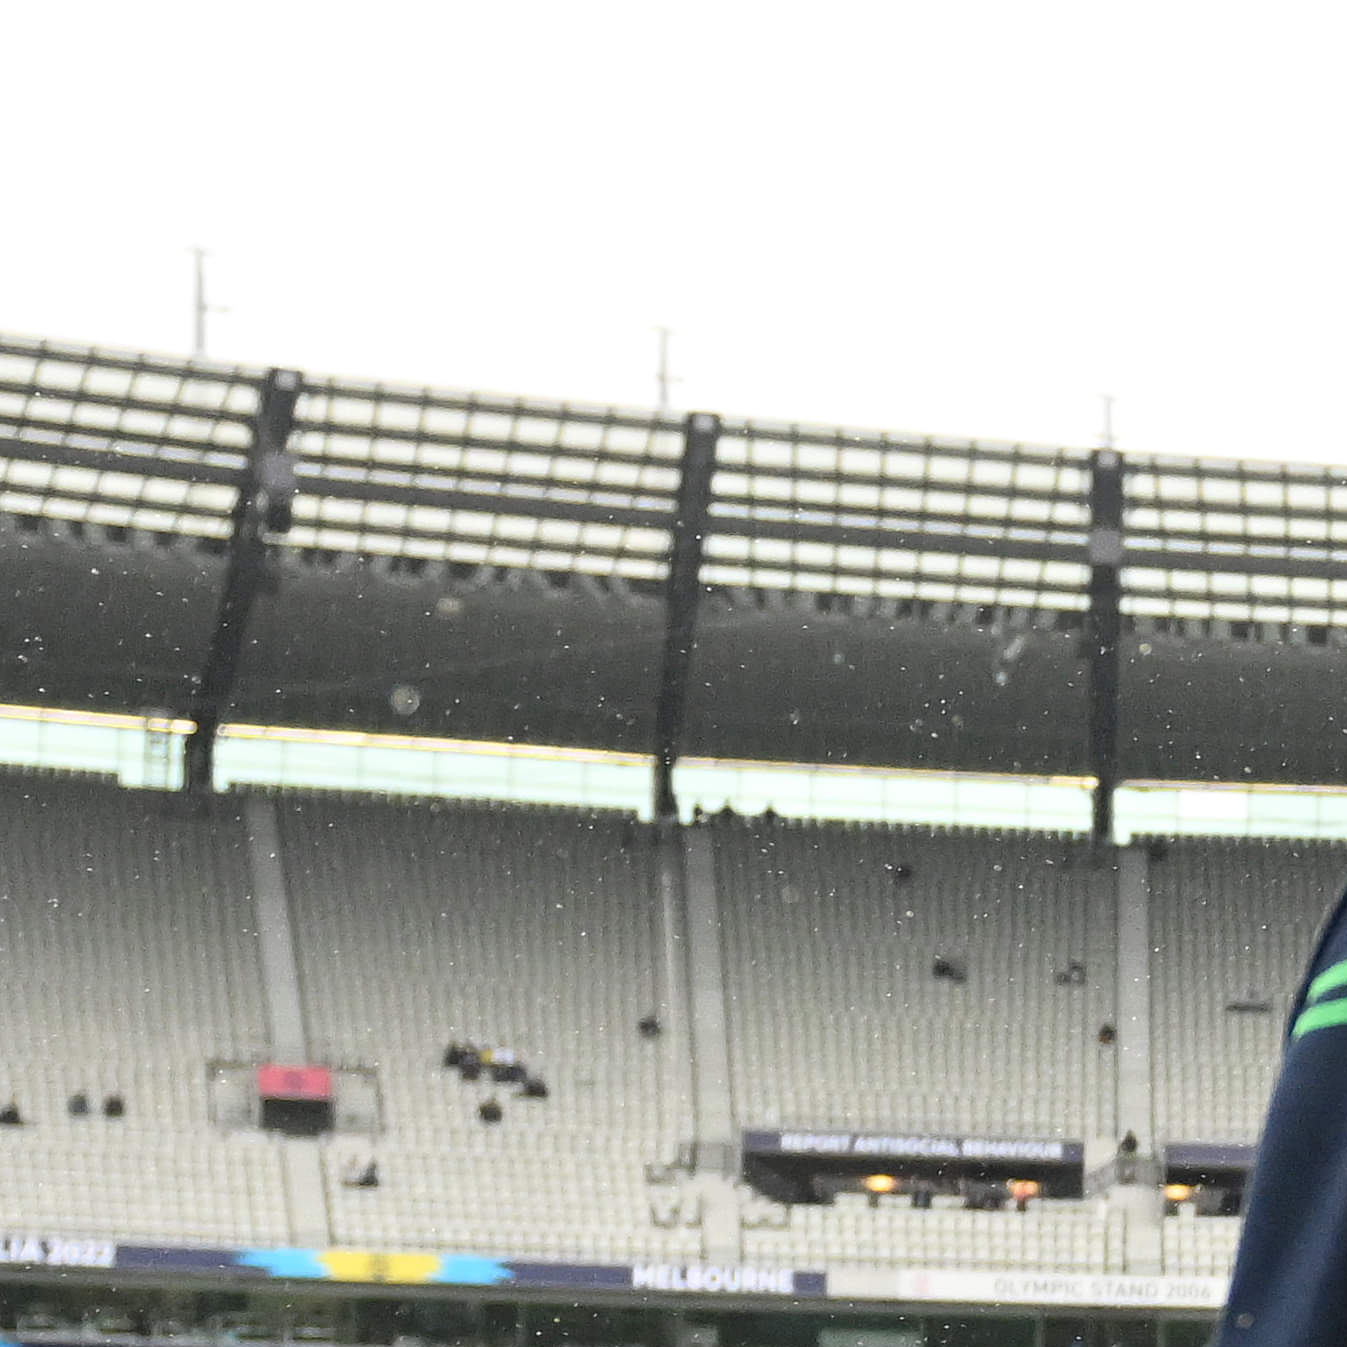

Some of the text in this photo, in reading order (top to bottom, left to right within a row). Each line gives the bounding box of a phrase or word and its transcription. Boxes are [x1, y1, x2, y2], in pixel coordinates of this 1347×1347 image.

[632, 1264, 794, 1294] MELBOURNE
[994, 1278, 1083, 1297] OLYMPIC
[1091, 1281, 1158, 1299] STAND
